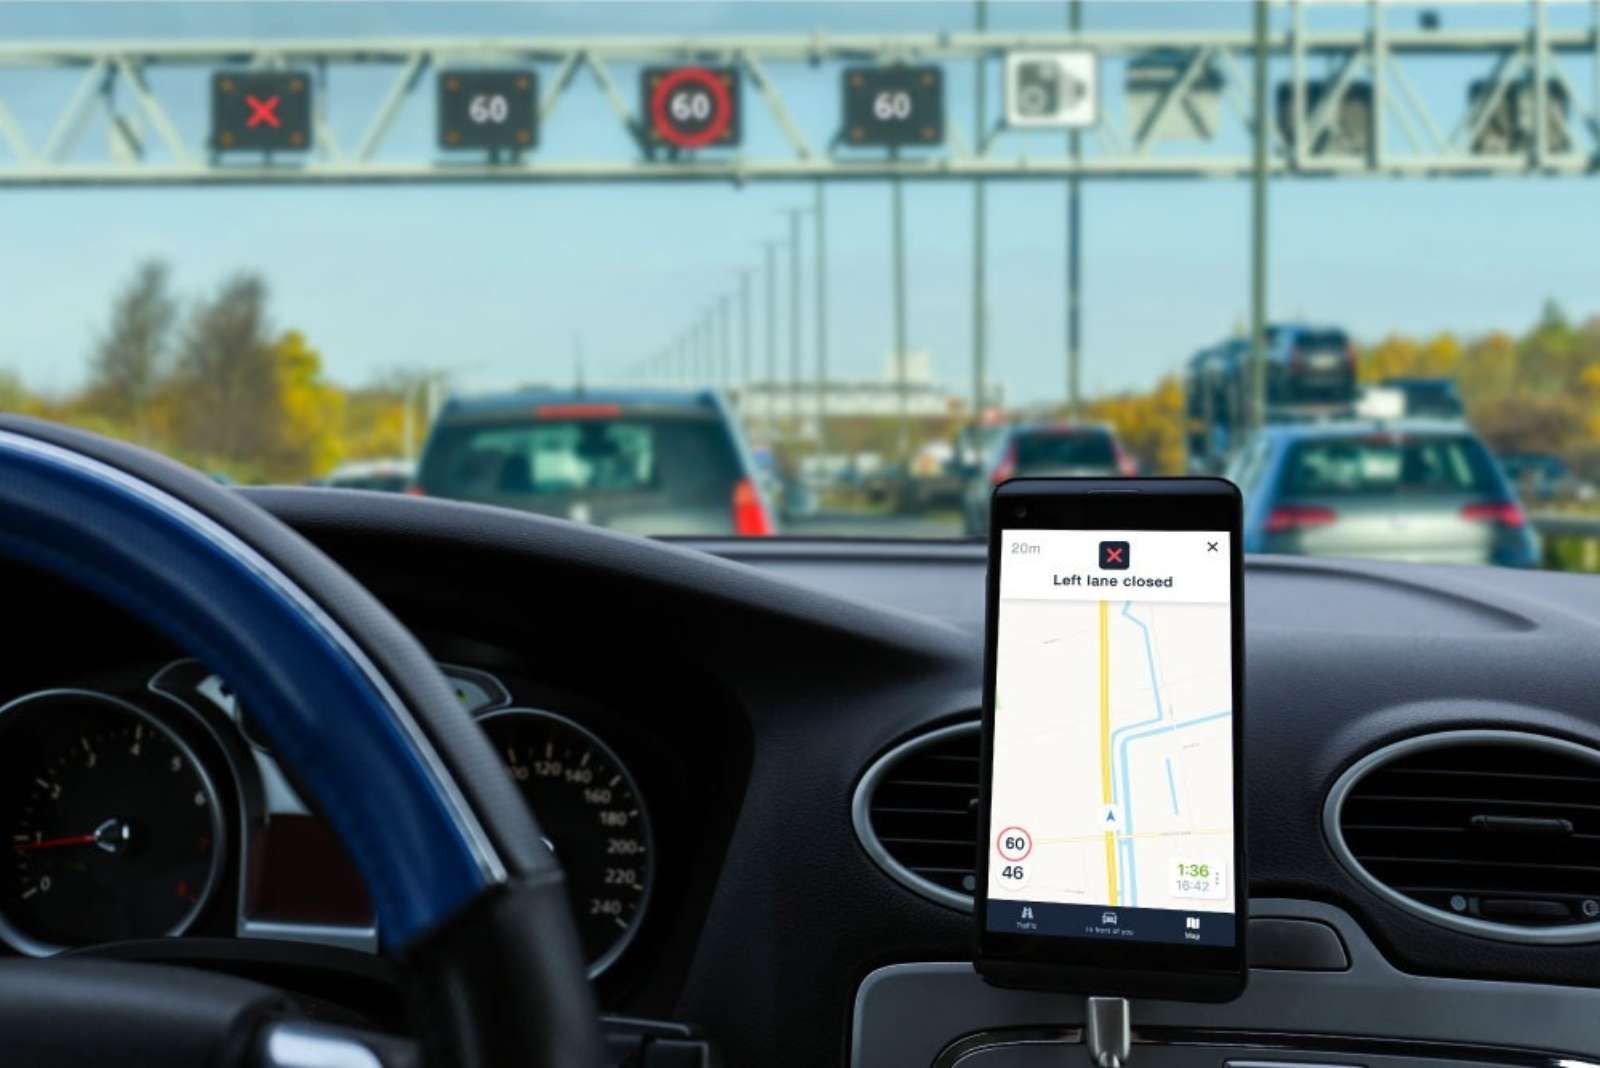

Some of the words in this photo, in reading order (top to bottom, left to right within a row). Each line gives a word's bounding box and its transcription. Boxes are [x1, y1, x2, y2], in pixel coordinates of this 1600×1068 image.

[469, 97, 507, 122] 60
[672, 95, 710, 120] 60
[875, 95, 911, 119] 60
[1011, 543, 1041, 555] 20m
[1053, 574, 1082, 586] Left
[1087, 575, 1118, 587] lane
[1123, 576, 1173, 588] closed
[534, 761, 562, 776] 120
[565, 768, 592, 784] 140
[584, 788, 611, 804] 160
[600, 811, 627, 826] 180
[608, 838, 637, 854] 200
[1005, 837, 1025, 850] 60
[605, 868, 636, 884] 220
[1002, 866, 1024, 879] 46
[1177, 864, 1209, 878] 1:36
[1176, 880, 1210, 892] 16:42
[590, 900, 621, 915] 240
